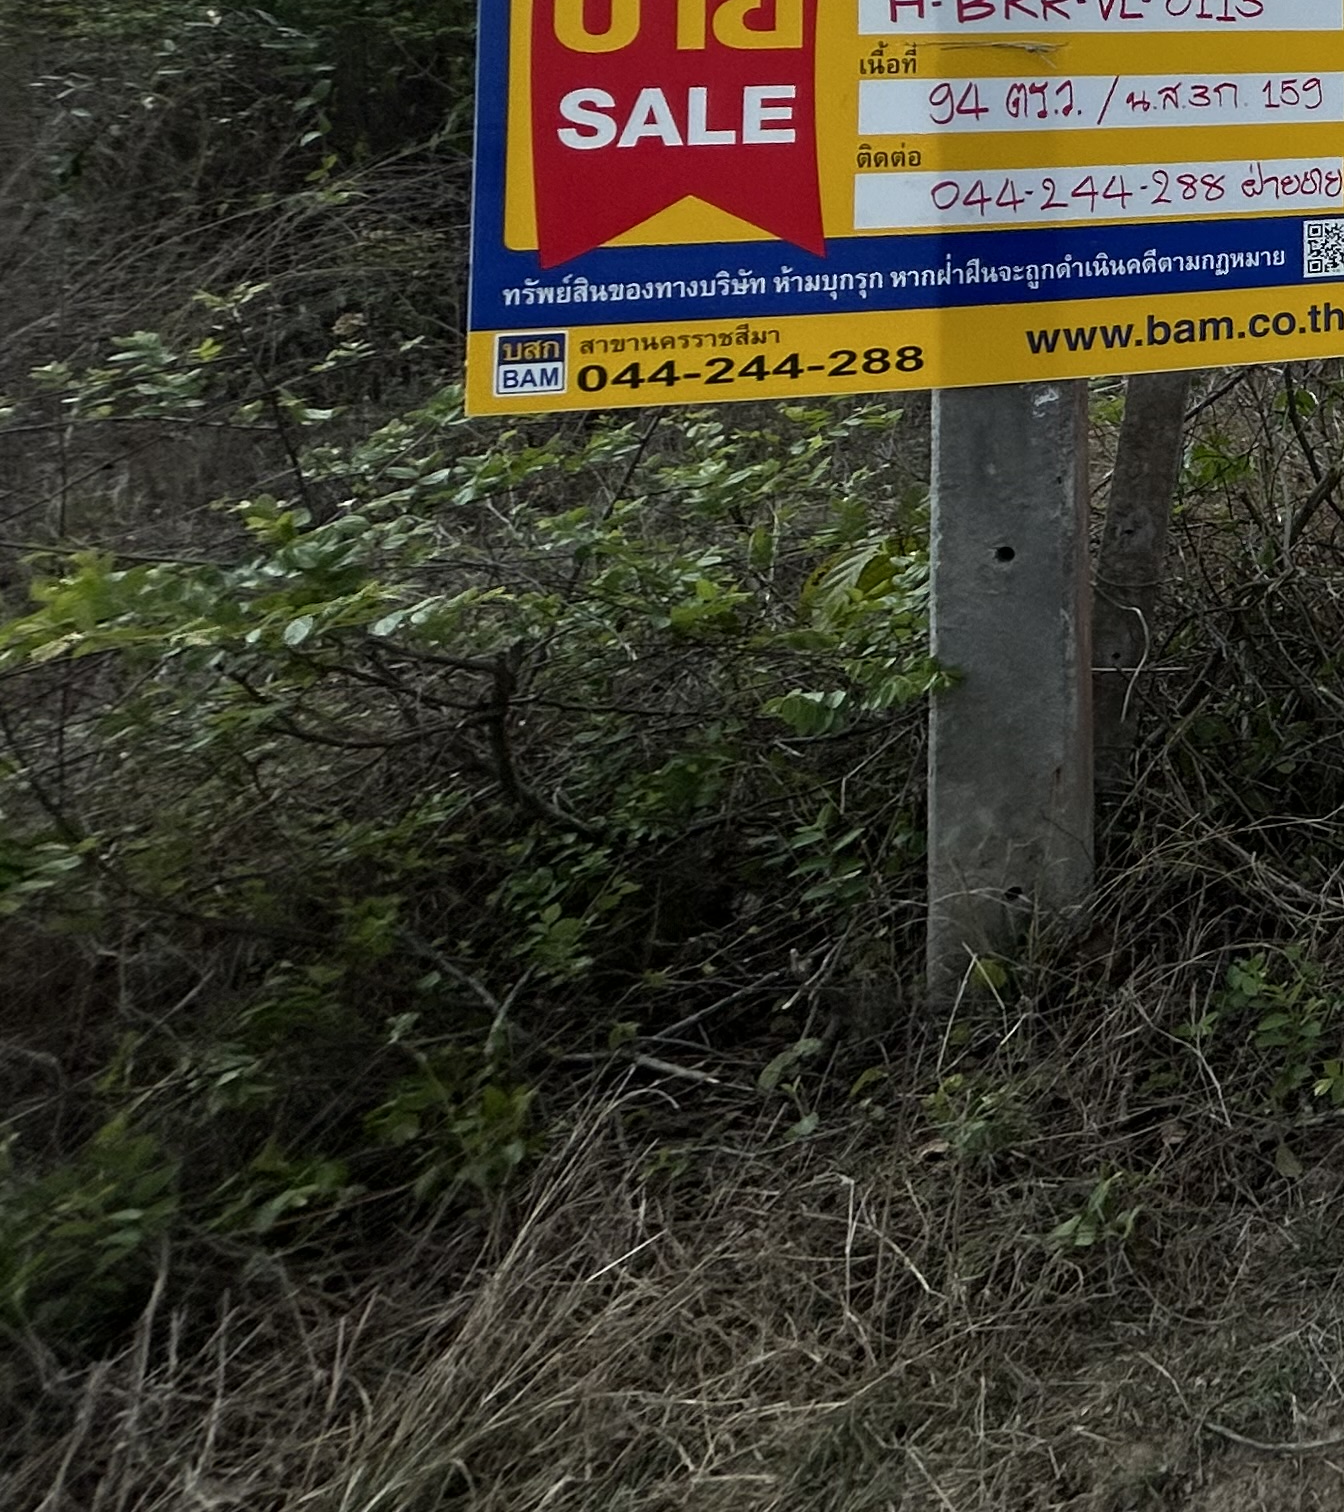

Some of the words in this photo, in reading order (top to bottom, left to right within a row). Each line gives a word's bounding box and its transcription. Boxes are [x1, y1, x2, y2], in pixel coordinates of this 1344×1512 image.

[859, 41, 917, 75] เนื้อที่
[556, 84, 797, 150] SALE
[929, 81, 990, 125] 94
[1262, 77, 1324, 110] 159
[856, 143, 922, 169] ติดต่อ
[930, 169, 1226, 217] 044-244-288
[502, 269, 766, 306] ทรัพย์สินของทางบริษัท
[773, 265, 883, 300] ห้ามบุกรุก
[579, 323, 781, 355] สาขานครราชสีมา
[1026, 302, 1344, 354] www.bam.co.th
[502, 340, 560, 361] บสก
[577, 345, 925, 392] 044-244-288
[503, 367, 559, 389] BAM
